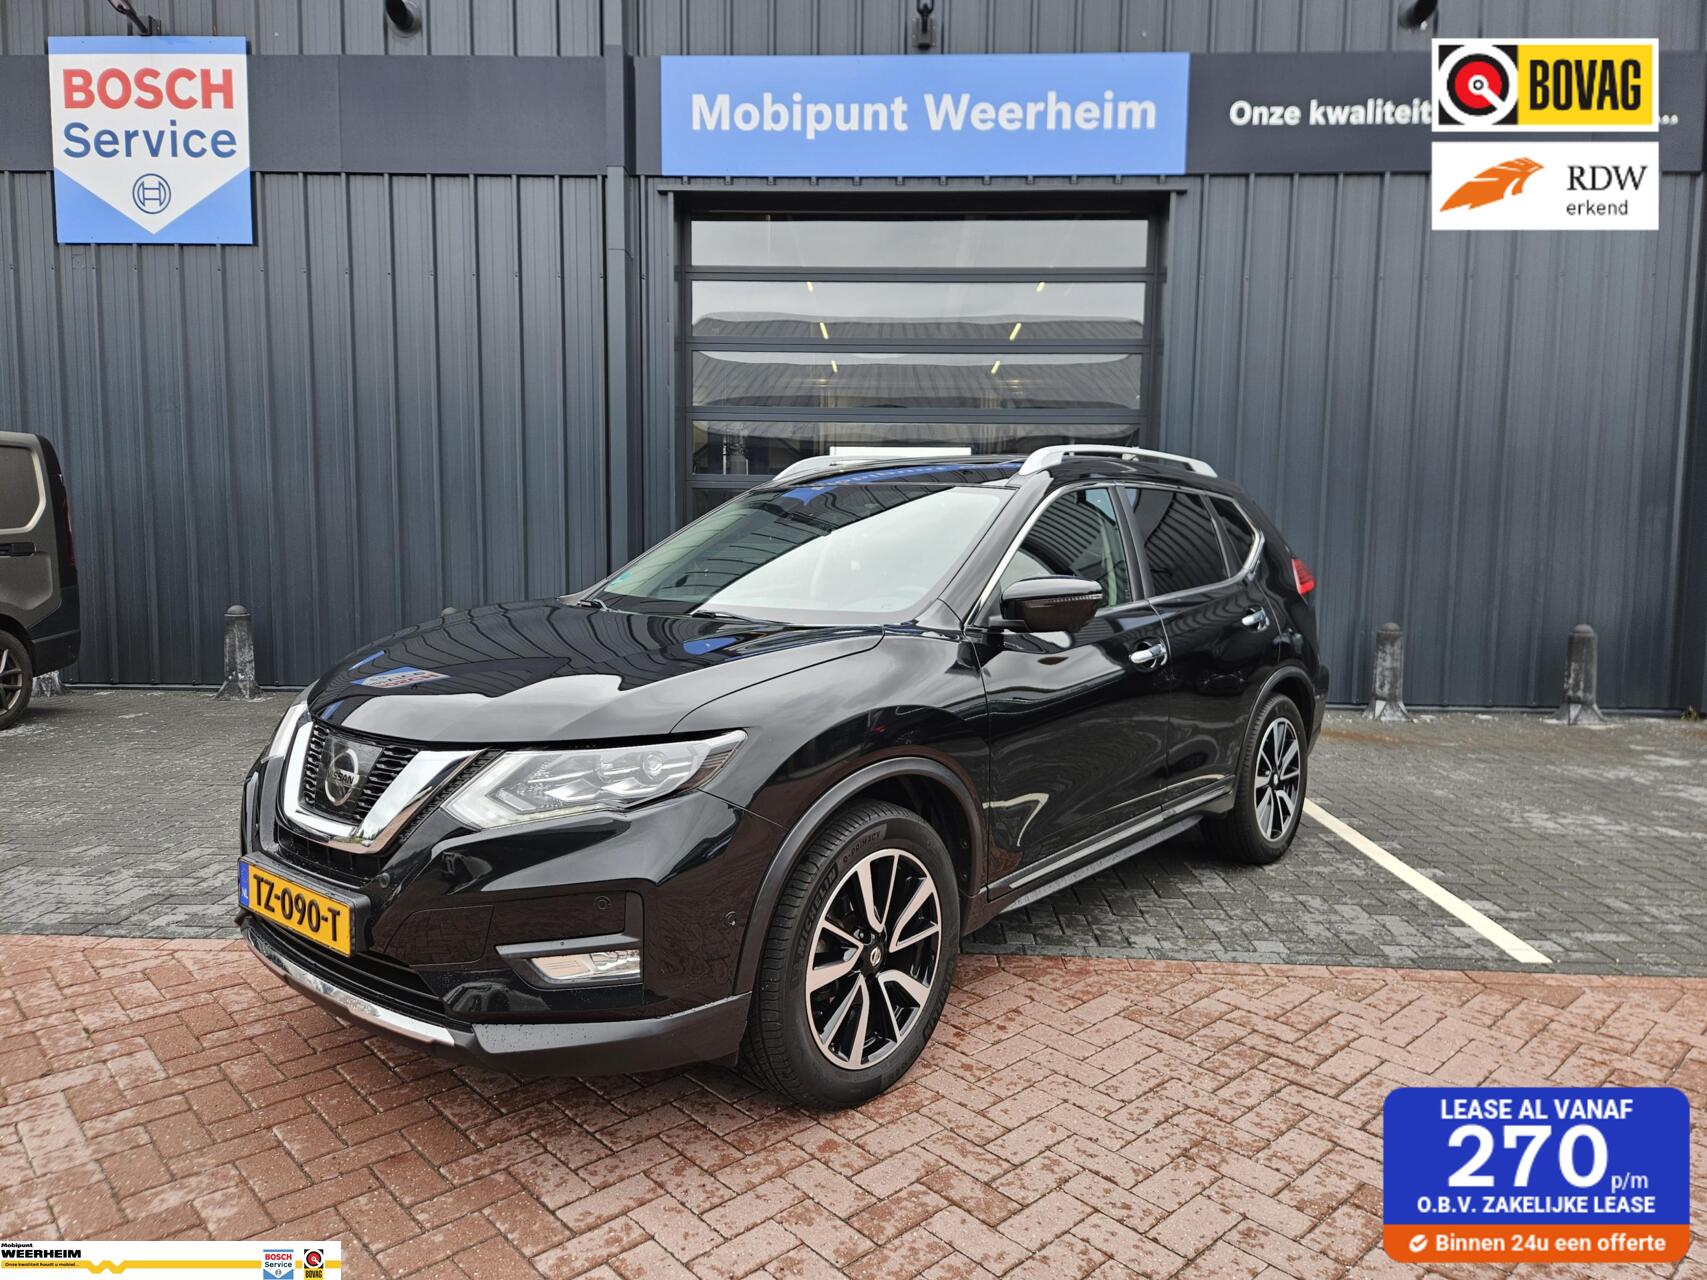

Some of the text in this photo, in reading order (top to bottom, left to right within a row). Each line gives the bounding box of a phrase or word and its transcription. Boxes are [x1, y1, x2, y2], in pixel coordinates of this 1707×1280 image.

[63, 67, 234, 110] BOSCH
[691, 89, 1157, 140] Mobipunt Weerheim
[1229, 97, 1432, 126] Onze kwaliteit
[63, 119, 236, 158] Service
[253, 874, 340, 941] TZ-090-T
